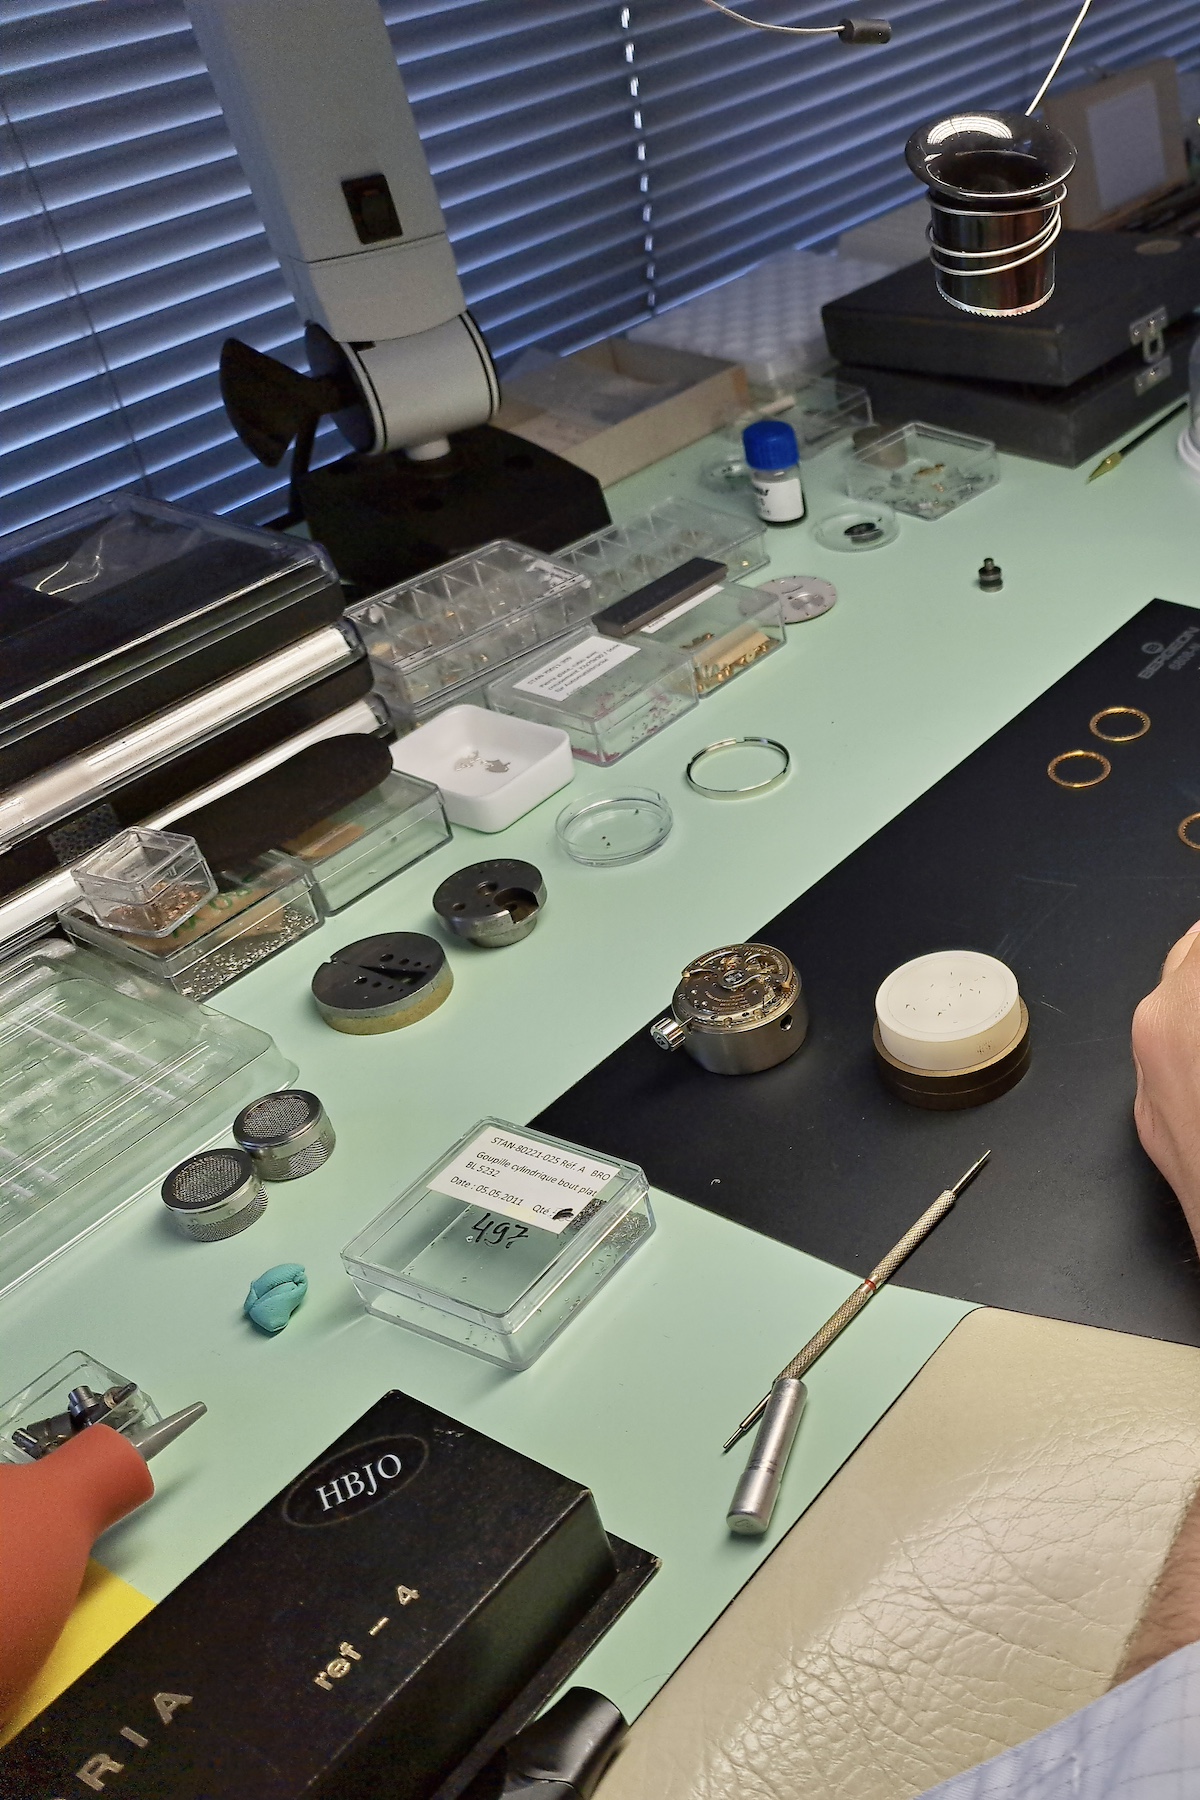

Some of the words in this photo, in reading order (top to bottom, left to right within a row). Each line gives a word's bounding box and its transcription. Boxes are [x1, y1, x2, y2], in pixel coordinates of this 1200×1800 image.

[1137, 626, 1200, 680] BERGEON
[465, 1161, 477, 1171] BL
[476, 1165, 501, 1178] 5232
[476, 1151, 511, 1168] Goupille
[510, 1164, 558, 1184] cylindrique
[557, 1178, 579, 1192] bout
[577, 1187, 598, 1198] plat
[490, 1137, 561, 1165] STAN-80221-025
[560, 1160, 576, 1171] Réf.
[577, 1166, 586, 1174] A
[590, 1169, 611, 1181] BRO
[450, 1175, 471, 1188] Date
[475, 1185, 524, 1206] 05.05.2011
[471, 1212, 529, 1249] 497
[315, 1454, 402, 1512] HBJO
[314, 1641, 362, 1692] ref
[397, 1584, 420, 1606] 4
[54, 1692, 193, 1800] RIA
